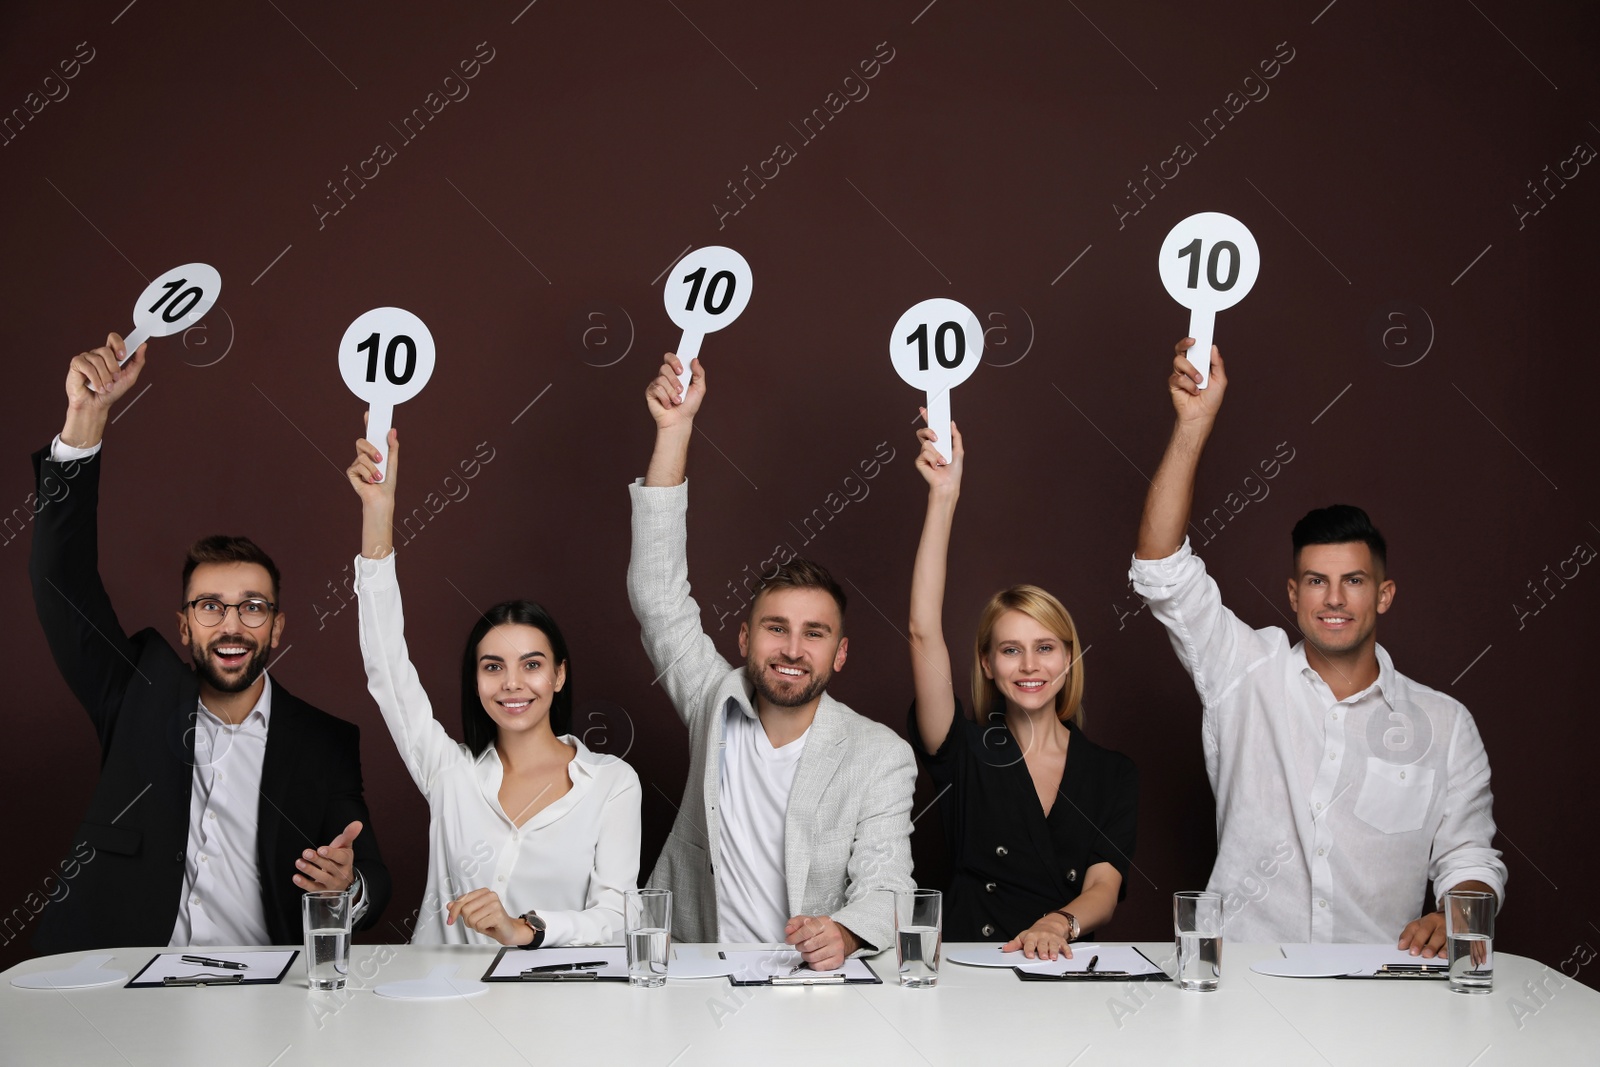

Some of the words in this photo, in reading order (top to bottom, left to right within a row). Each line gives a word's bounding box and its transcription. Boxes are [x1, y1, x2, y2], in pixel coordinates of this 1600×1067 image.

[1178, 239, 1240, 291] 10
[149, 279, 203, 323] 10
[683, 267, 736, 315] 10
[357, 333, 416, 385] 10
[907, 321, 965, 370] 10
